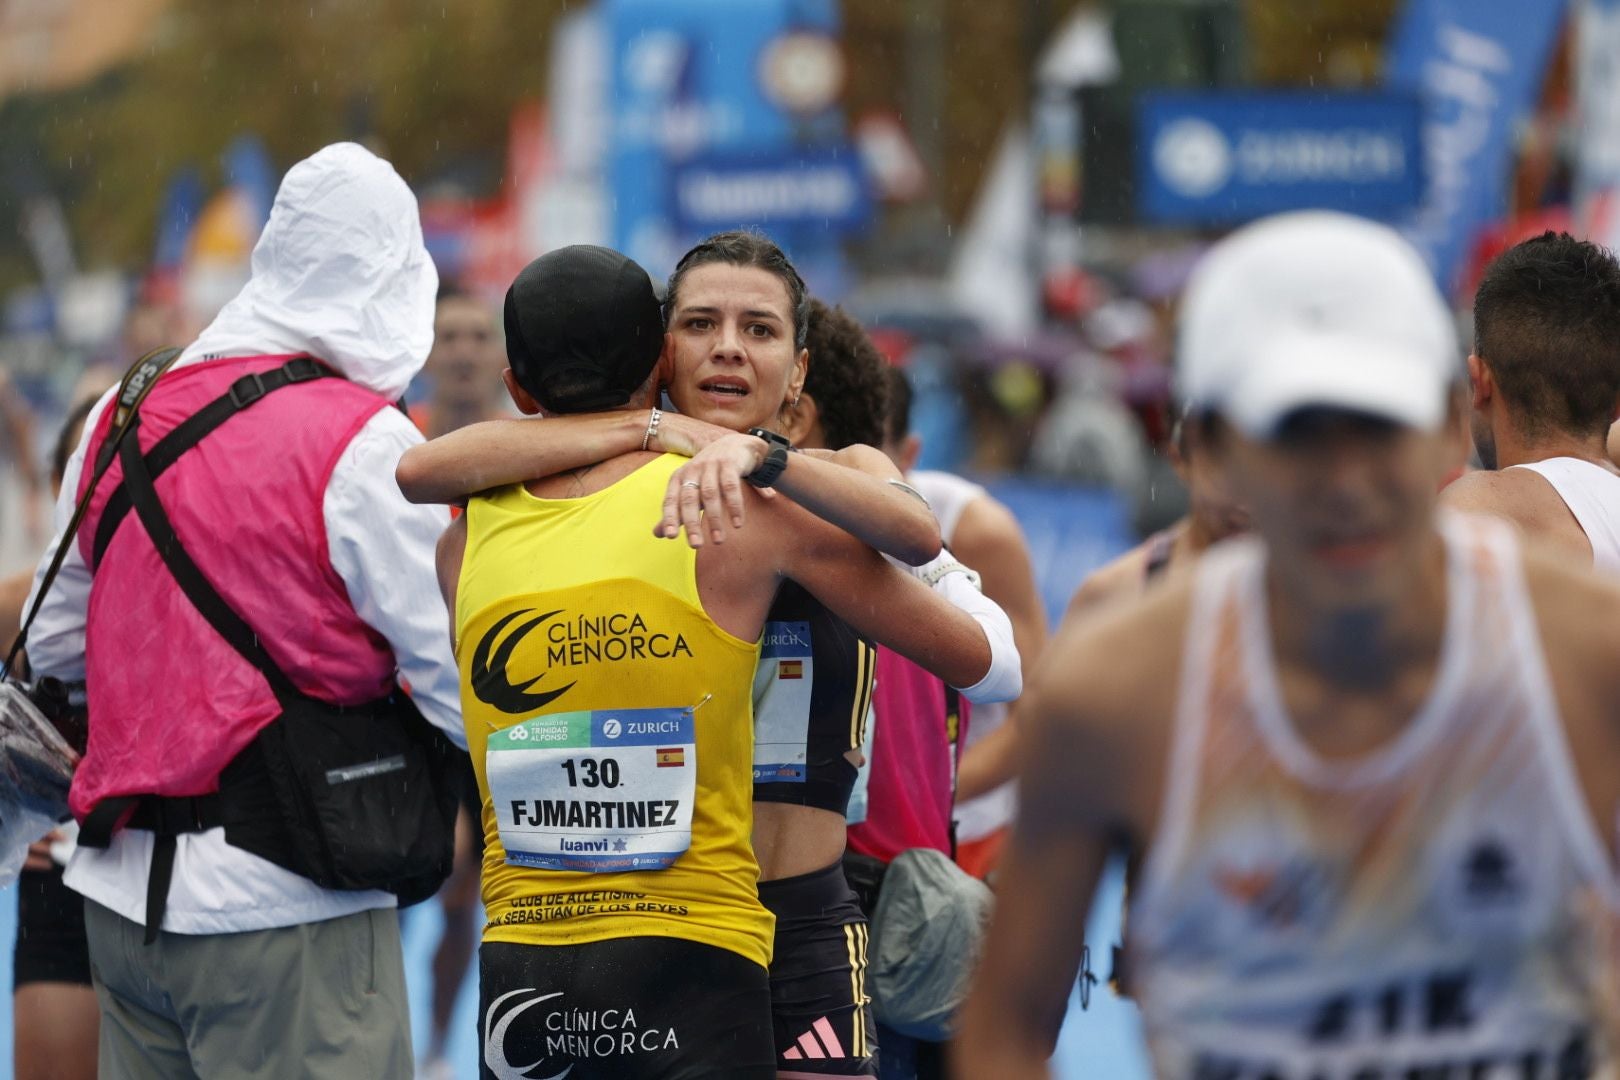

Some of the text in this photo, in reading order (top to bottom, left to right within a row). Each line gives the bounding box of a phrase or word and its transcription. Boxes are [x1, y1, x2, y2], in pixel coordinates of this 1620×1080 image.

[121, 362, 158, 406] NPS
[548, 613, 647, 643] CLÍNICA
[763, 634, 798, 646] URICH
[548, 634, 693, 668] MENORCA
[531, 726, 568, 735] TRINIDAD
[531, 734, 568, 742] ALFONSO
[628, 721, 680, 734] ZURICH
[511, 800, 679, 828] FJMARTINEZ
[511, 896, 542, 907] CLUB
[546, 894, 563, 905] DE
[504, 907, 572, 925] SEBASTIAN
[600, 904, 630, 912] LOS
[635, 902, 689, 915] REYES
[546, 1007, 637, 1032] CLÍNICA
[546, 1027, 679, 1058] MENORCA
